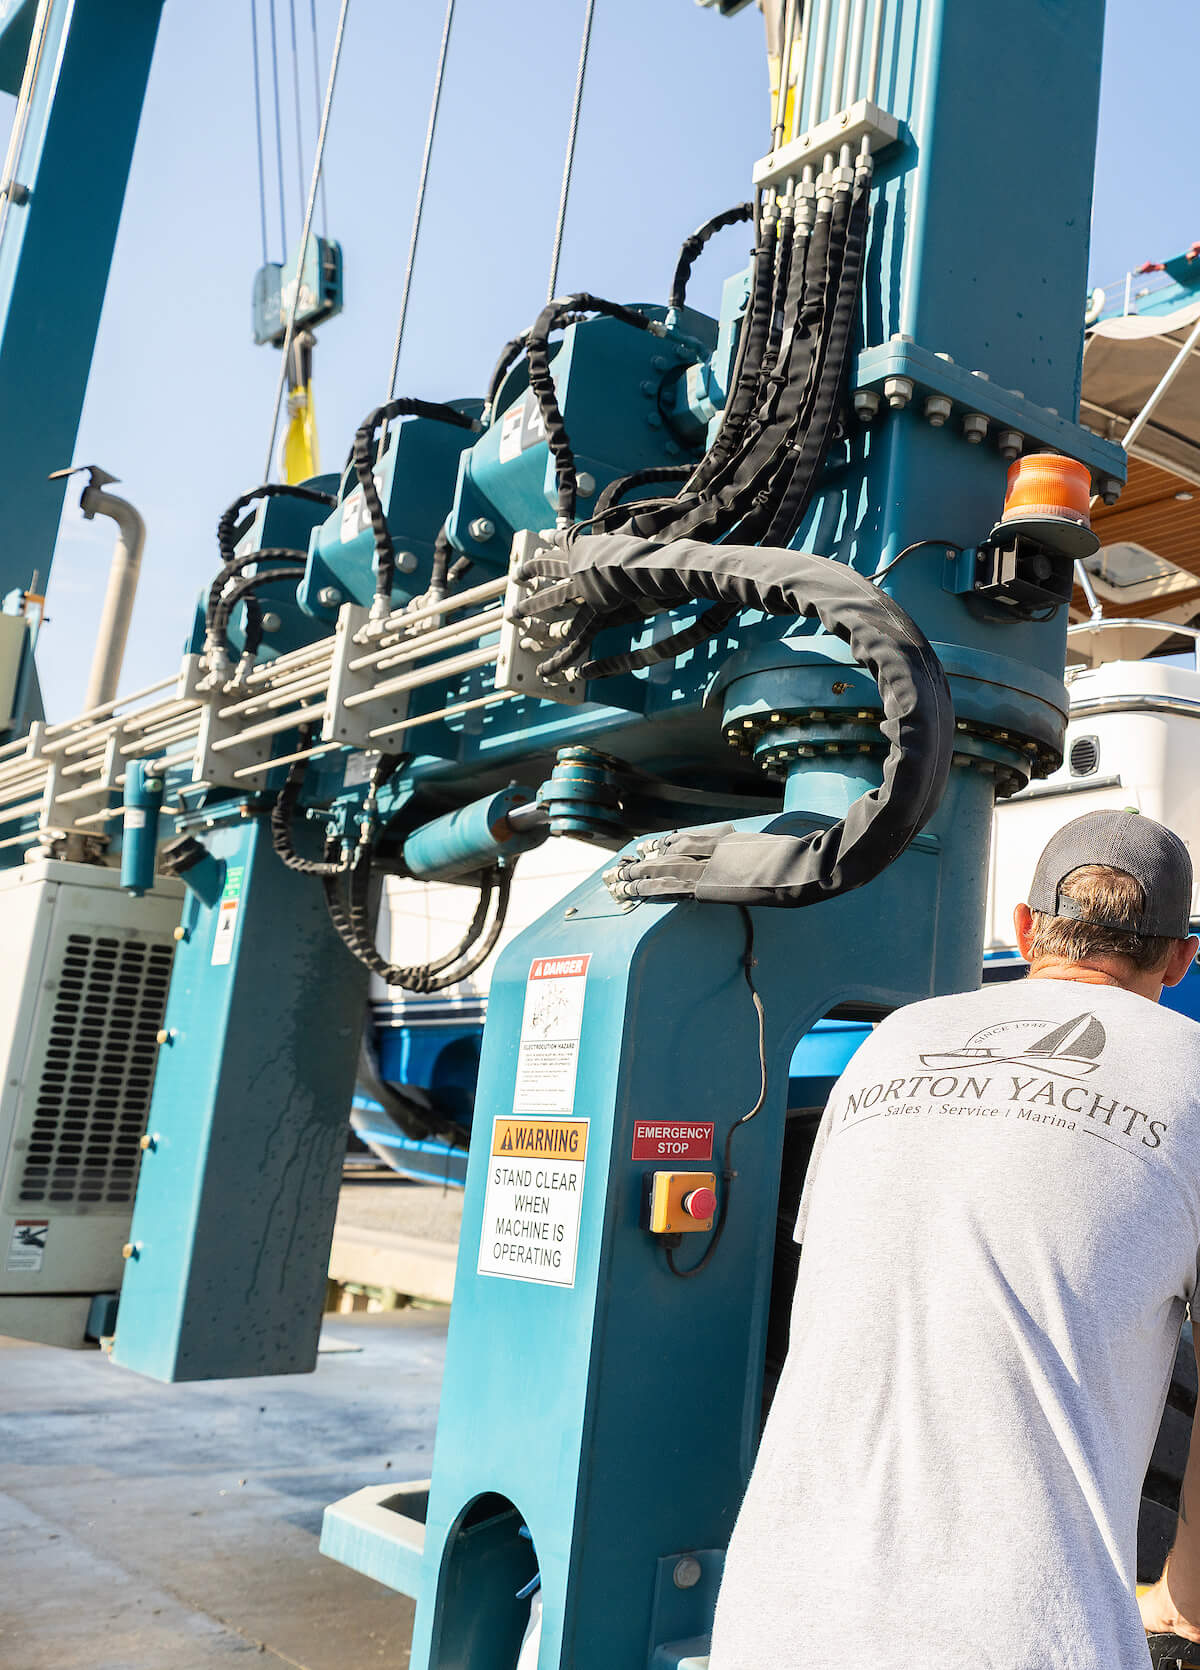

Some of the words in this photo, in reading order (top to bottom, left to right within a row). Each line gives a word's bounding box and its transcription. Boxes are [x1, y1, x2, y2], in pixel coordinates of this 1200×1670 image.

[528, 401, 546, 438] 4
[542, 959, 584, 977] DANGER
[974, 1026, 1009, 1044] SINCE
[842, 1076, 993, 1122] NORTON
[1008, 1076, 1167, 1149] YACHTS
[884, 1103, 922, 1117] Sales
[939, 1103, 999, 1118] Service
[1016, 1108, 1076, 1131] Marina
[514, 1127, 579, 1153] WARNING
[637, 1126, 711, 1139] EMERGENCY
[657, 1142, 689, 1154] STOP
[494, 1168, 532, 1188] STAND
[535, 1171, 578, 1192] CLEAR
[514, 1194, 550, 1215] WHEN
[495, 1217, 550, 1241] MACHINE
[552, 1223, 565, 1242] IS
[493, 1242, 562, 1268] OPERATING
